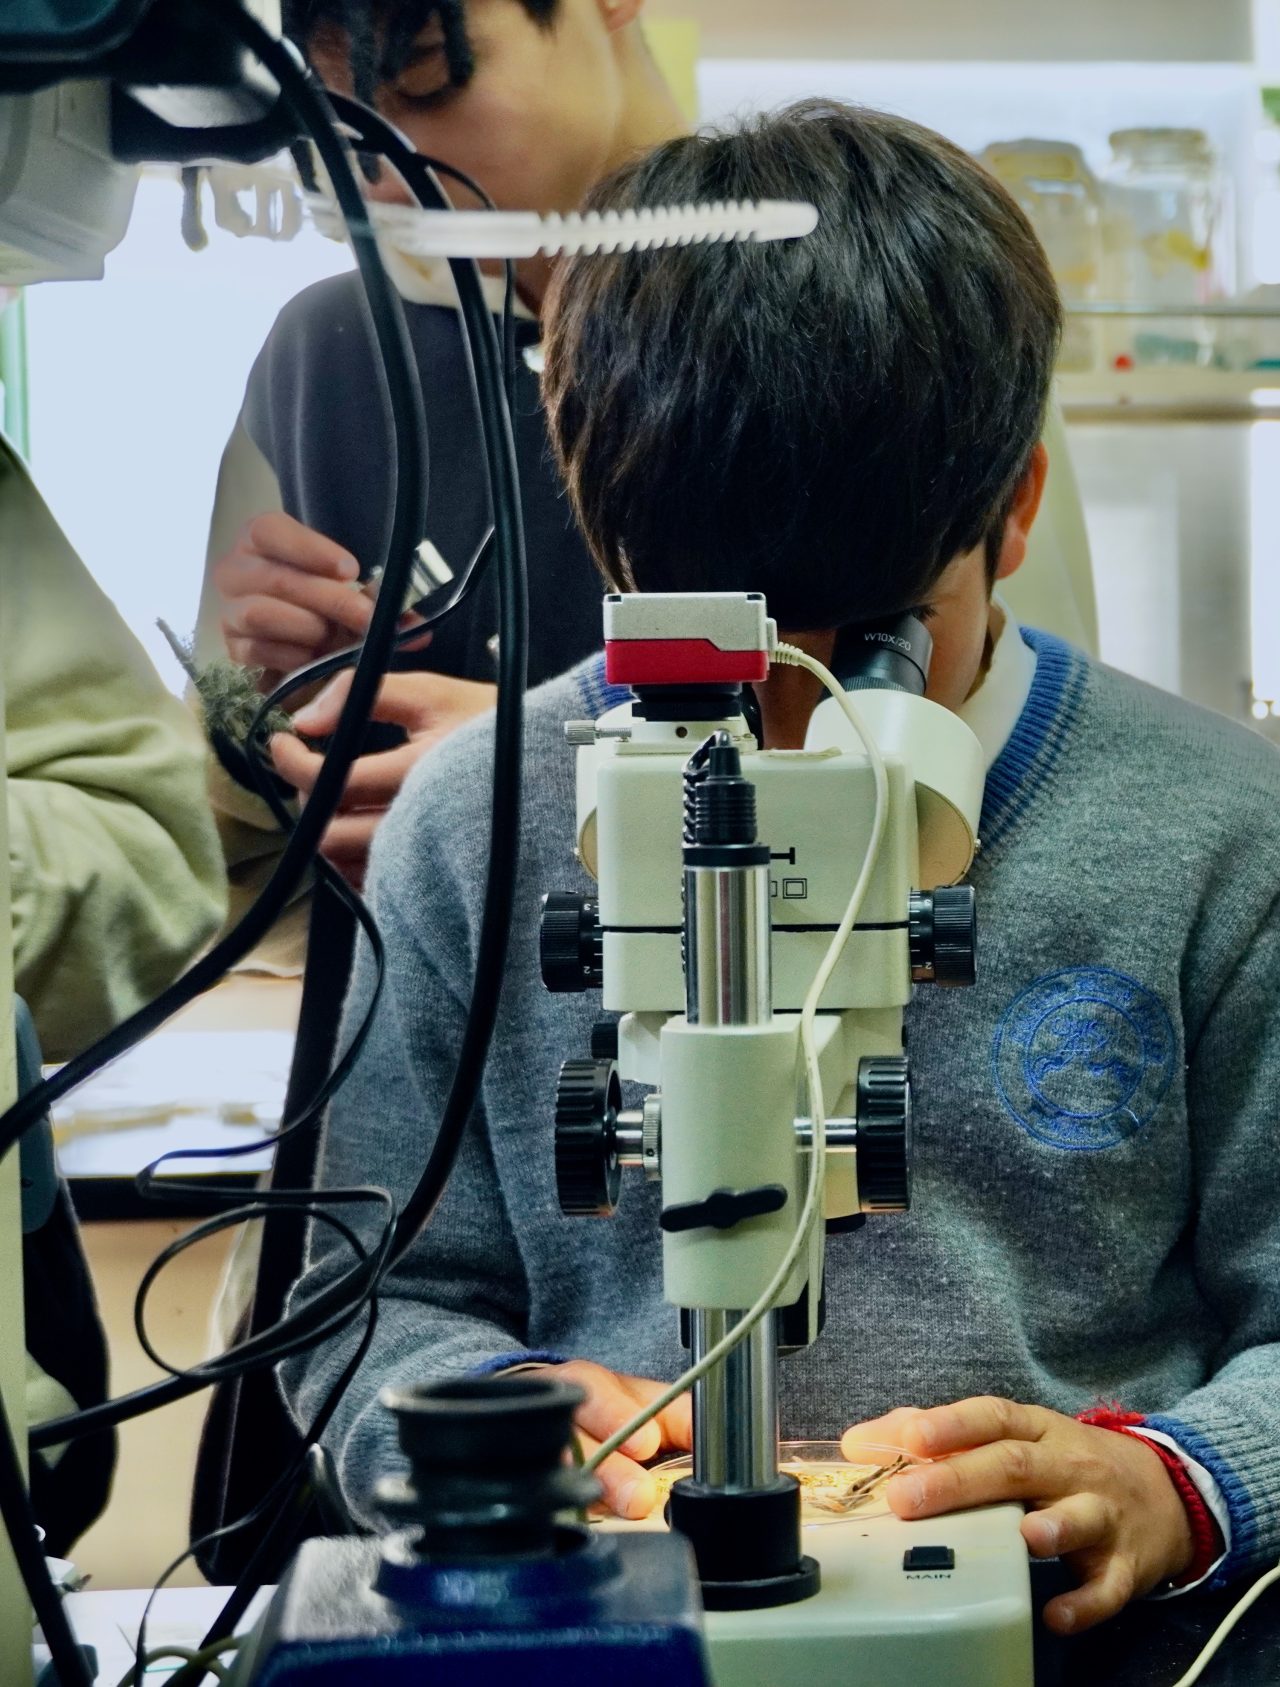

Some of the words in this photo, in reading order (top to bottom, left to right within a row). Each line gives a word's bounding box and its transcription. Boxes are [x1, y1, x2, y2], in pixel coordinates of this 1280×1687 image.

[583, 903, 592, 911] 3
[583, 965, 591, 974] 2
[925, 961, 932, 970] 2
[906, 1573, 952, 1581] MAIN
